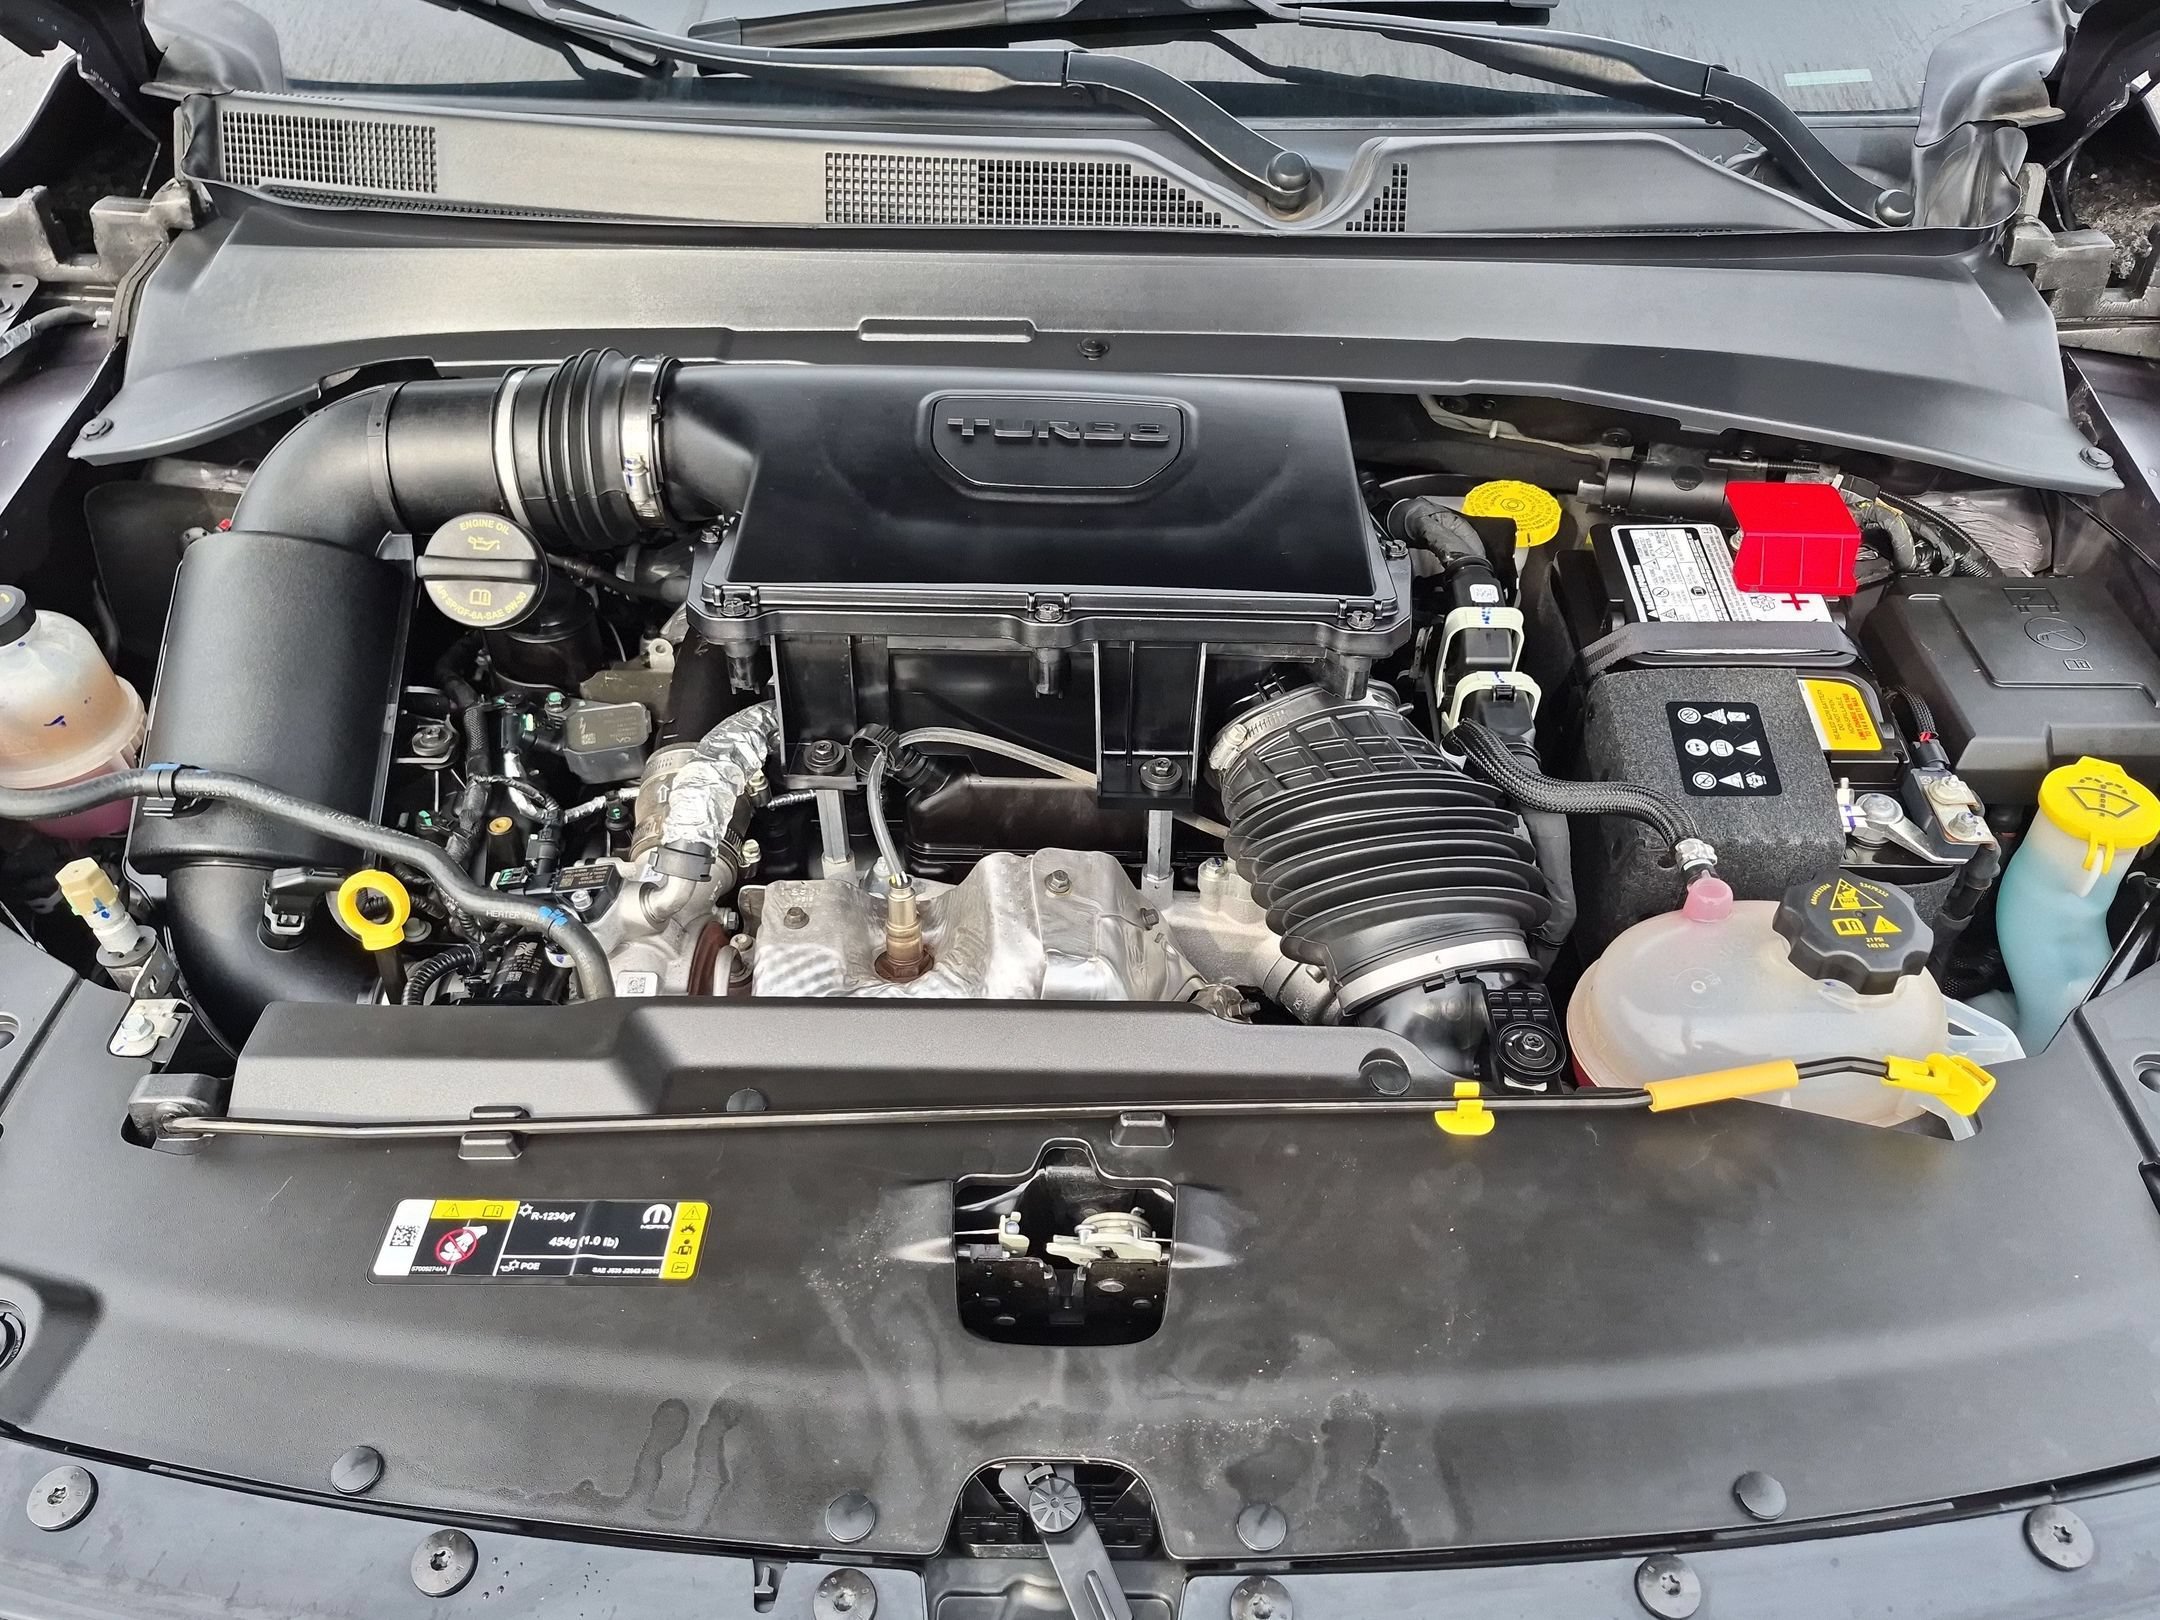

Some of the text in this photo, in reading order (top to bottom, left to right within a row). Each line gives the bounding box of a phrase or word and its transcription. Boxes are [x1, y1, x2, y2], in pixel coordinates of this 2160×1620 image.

[947, 417, 1170, 442] TURBO
[459, 519, 510, 535] ENGINE OIL
[486, 909, 521, 919] HEATER
[531, 1211, 576, 1223] R-1234yf
[548, 1235, 619, 1249] 454g (1.0 lb)
[520, 1262, 541, 1271] POE
